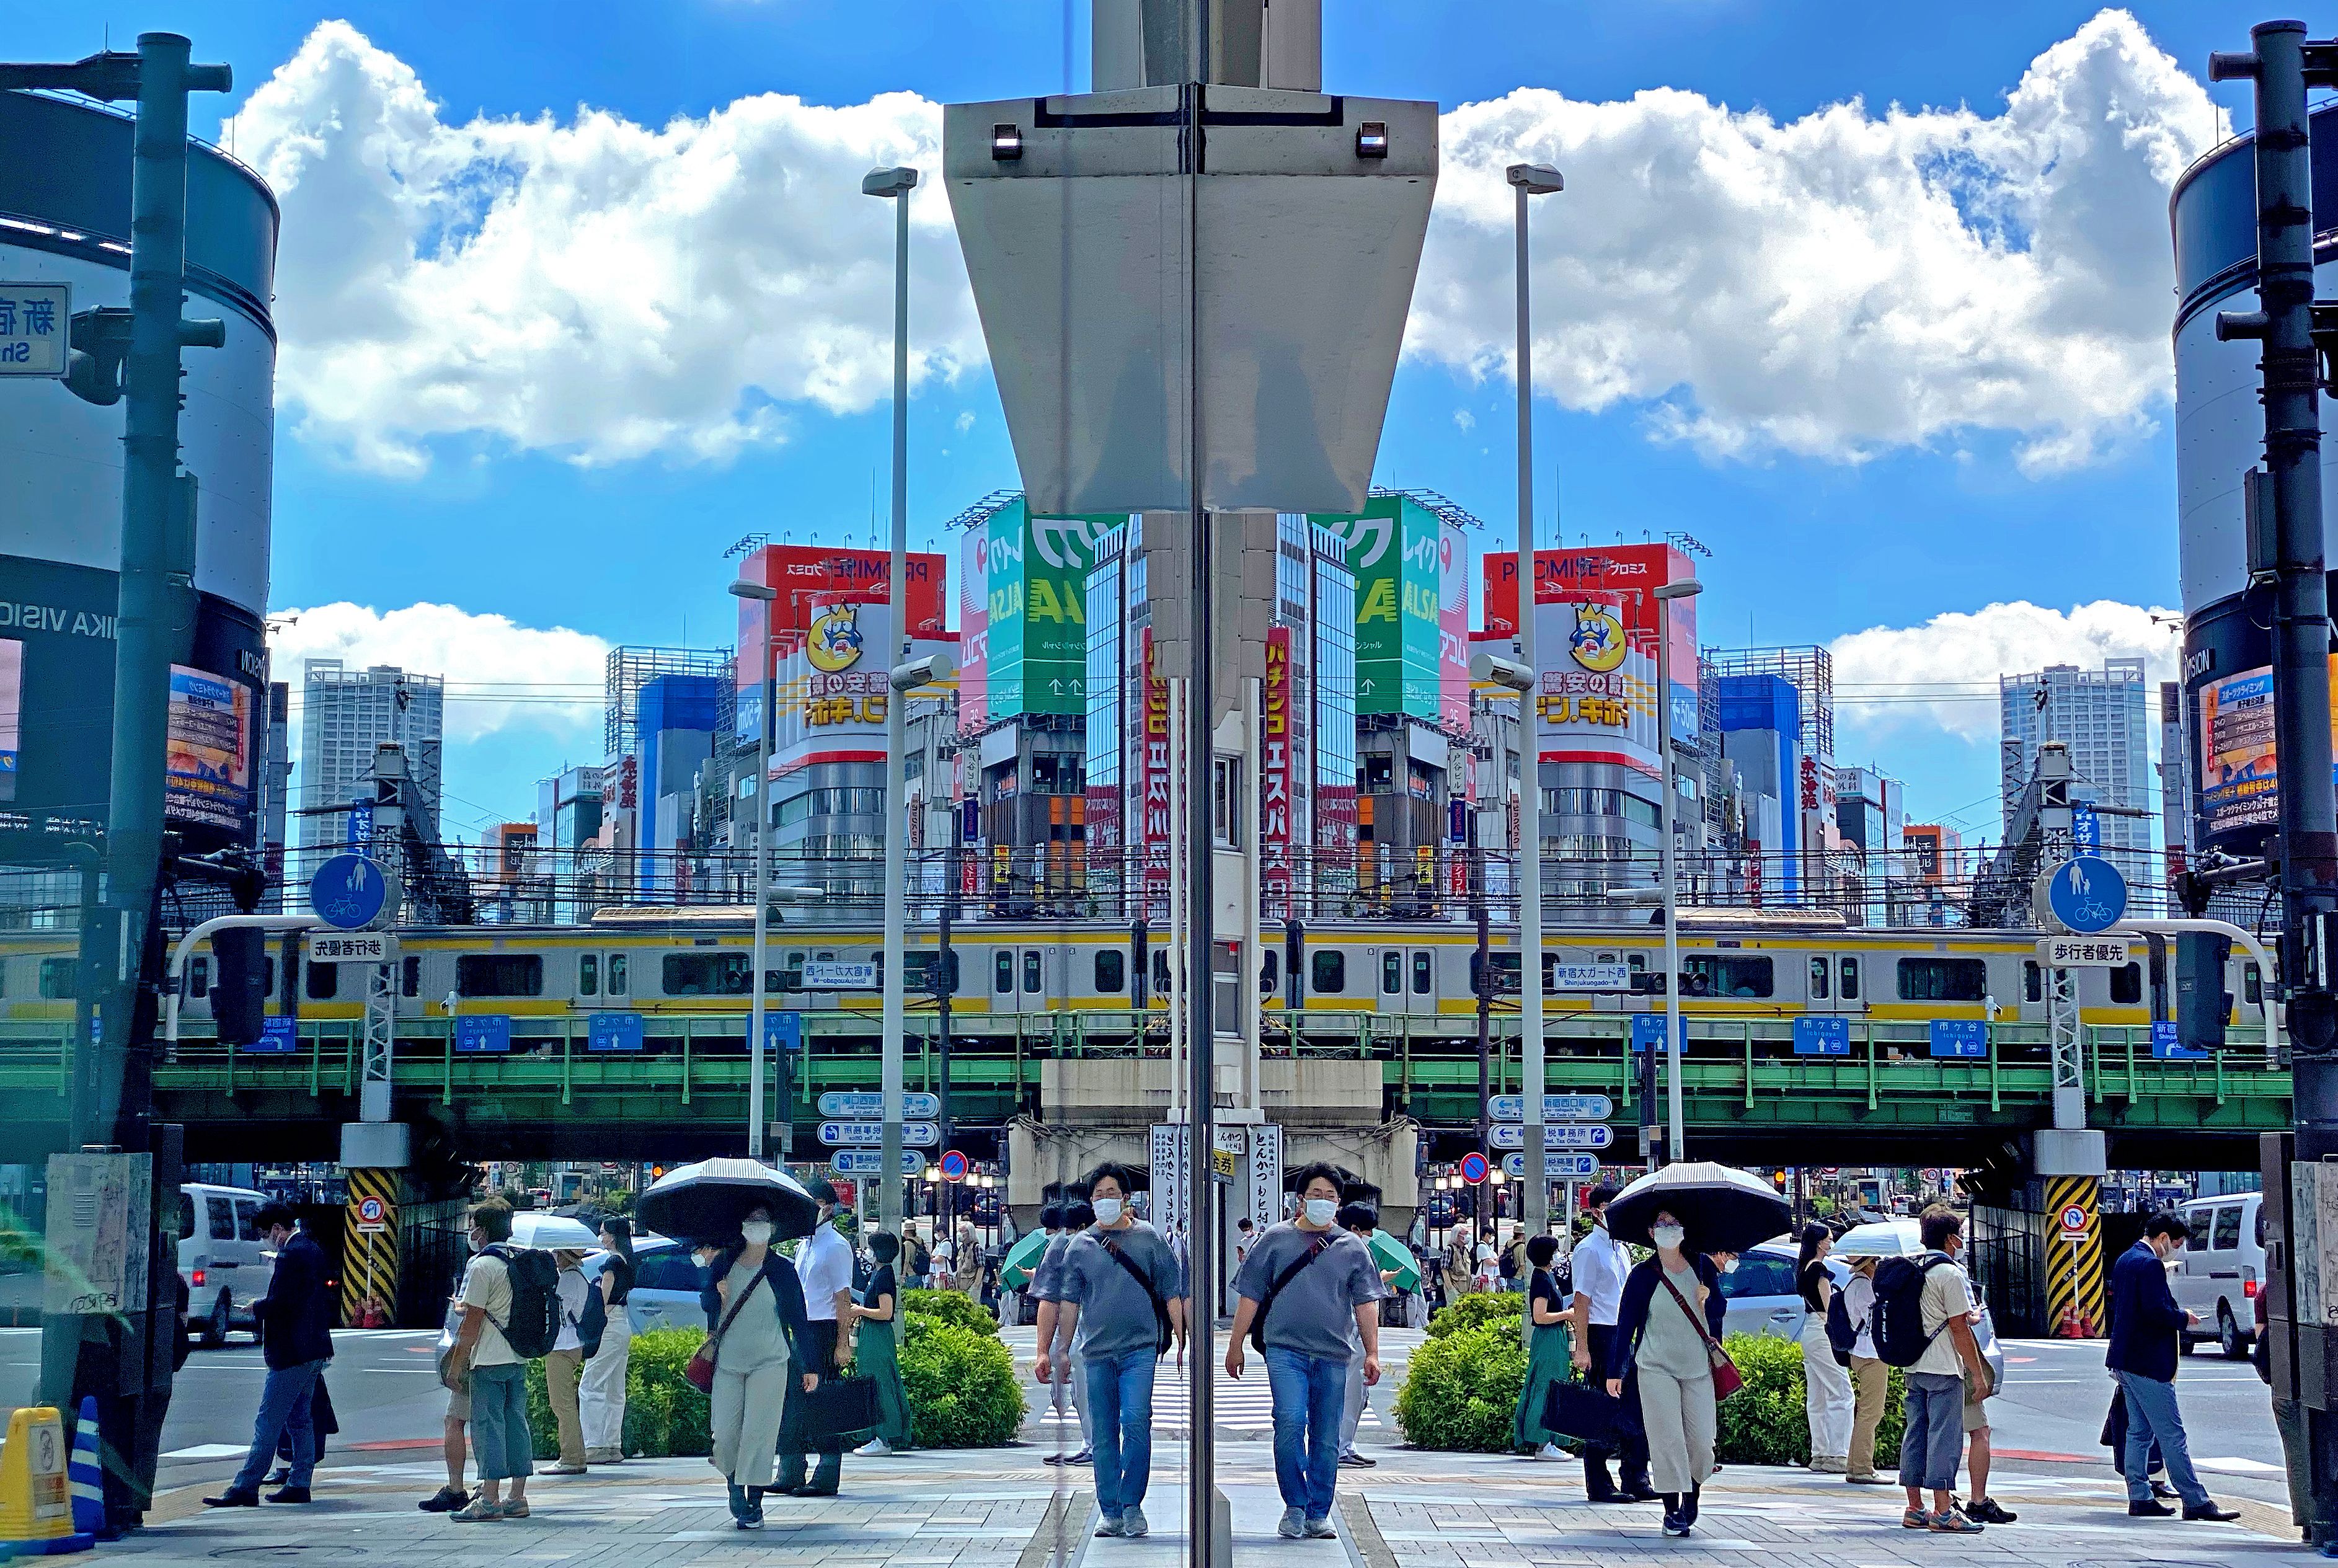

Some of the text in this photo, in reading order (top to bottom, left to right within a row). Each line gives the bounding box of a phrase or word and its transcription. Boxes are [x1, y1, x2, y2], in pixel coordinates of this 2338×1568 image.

[1403, 525, 1437, 574] レイク
[1610, 562, 1647, 575] プロミス
[1402, 580, 1439, 626] ALSA
[1440, 629, 1466, 668] アコム
[1267, 642, 1285, 733] パチンコ
[1680, 701, 1696, 732] 50m
[1801, 755, 1818, 811] 東海苑
[1838, 782, 1857, 791] 外科
[2055, 944, 2122, 960] 歩行者優先
[1558, 967, 1626, 978] 新宿大ガード西
[1256, 1133, 1269, 1180] とんかつ
